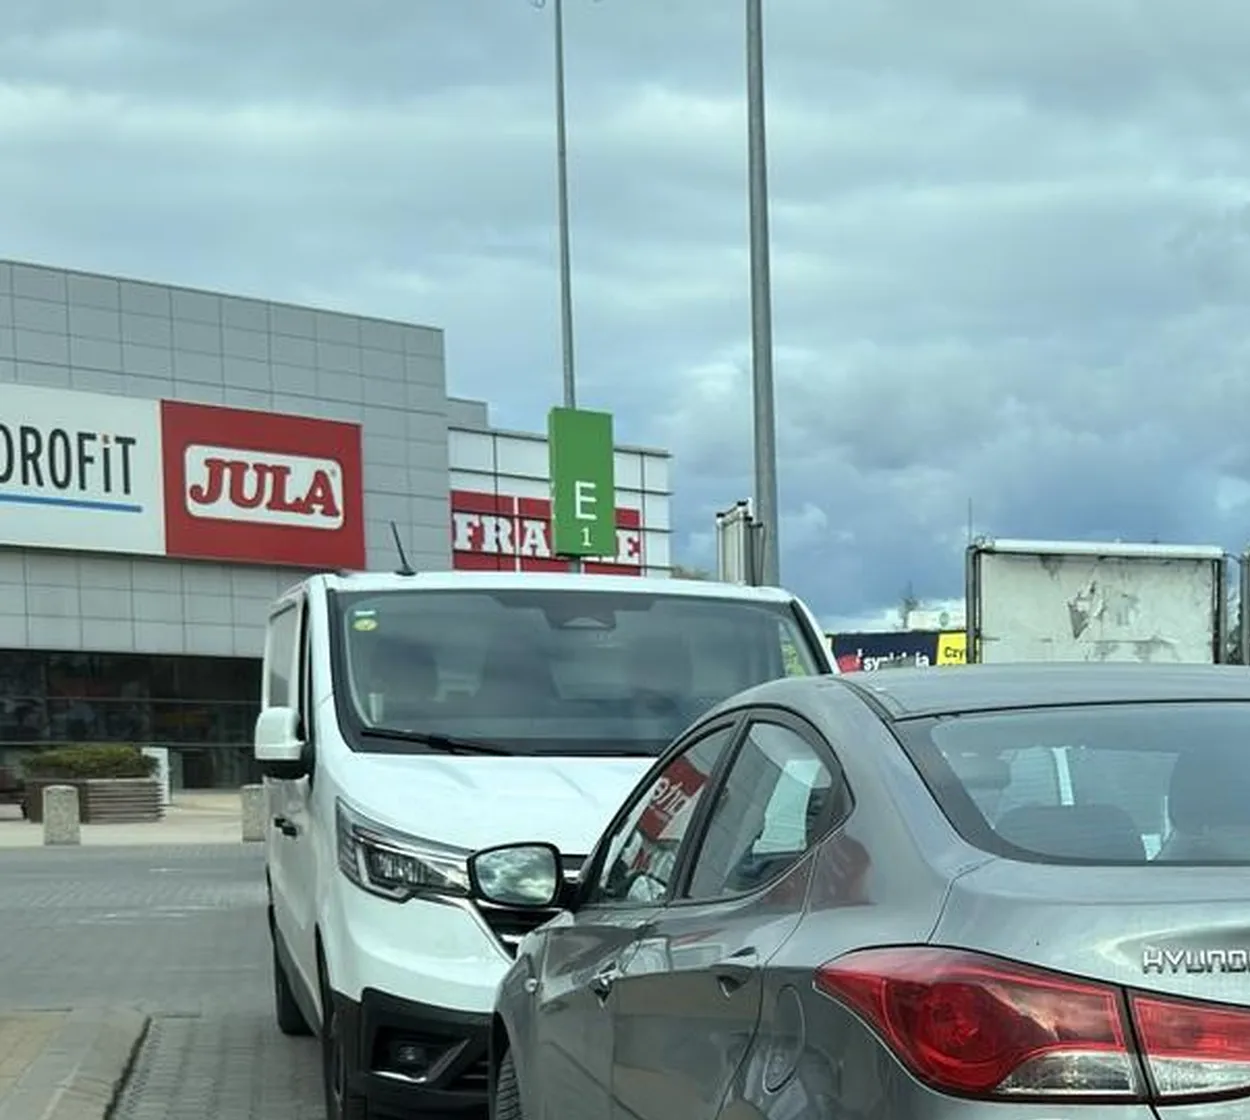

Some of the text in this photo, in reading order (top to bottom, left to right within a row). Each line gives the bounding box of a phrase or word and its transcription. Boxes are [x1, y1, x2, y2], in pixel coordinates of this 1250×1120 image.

[190, 458, 340, 518] JULA
[575, 481, 598, 520] E
[453, 513, 639, 564] FRAE
[581, 528, 593, 547] 1
